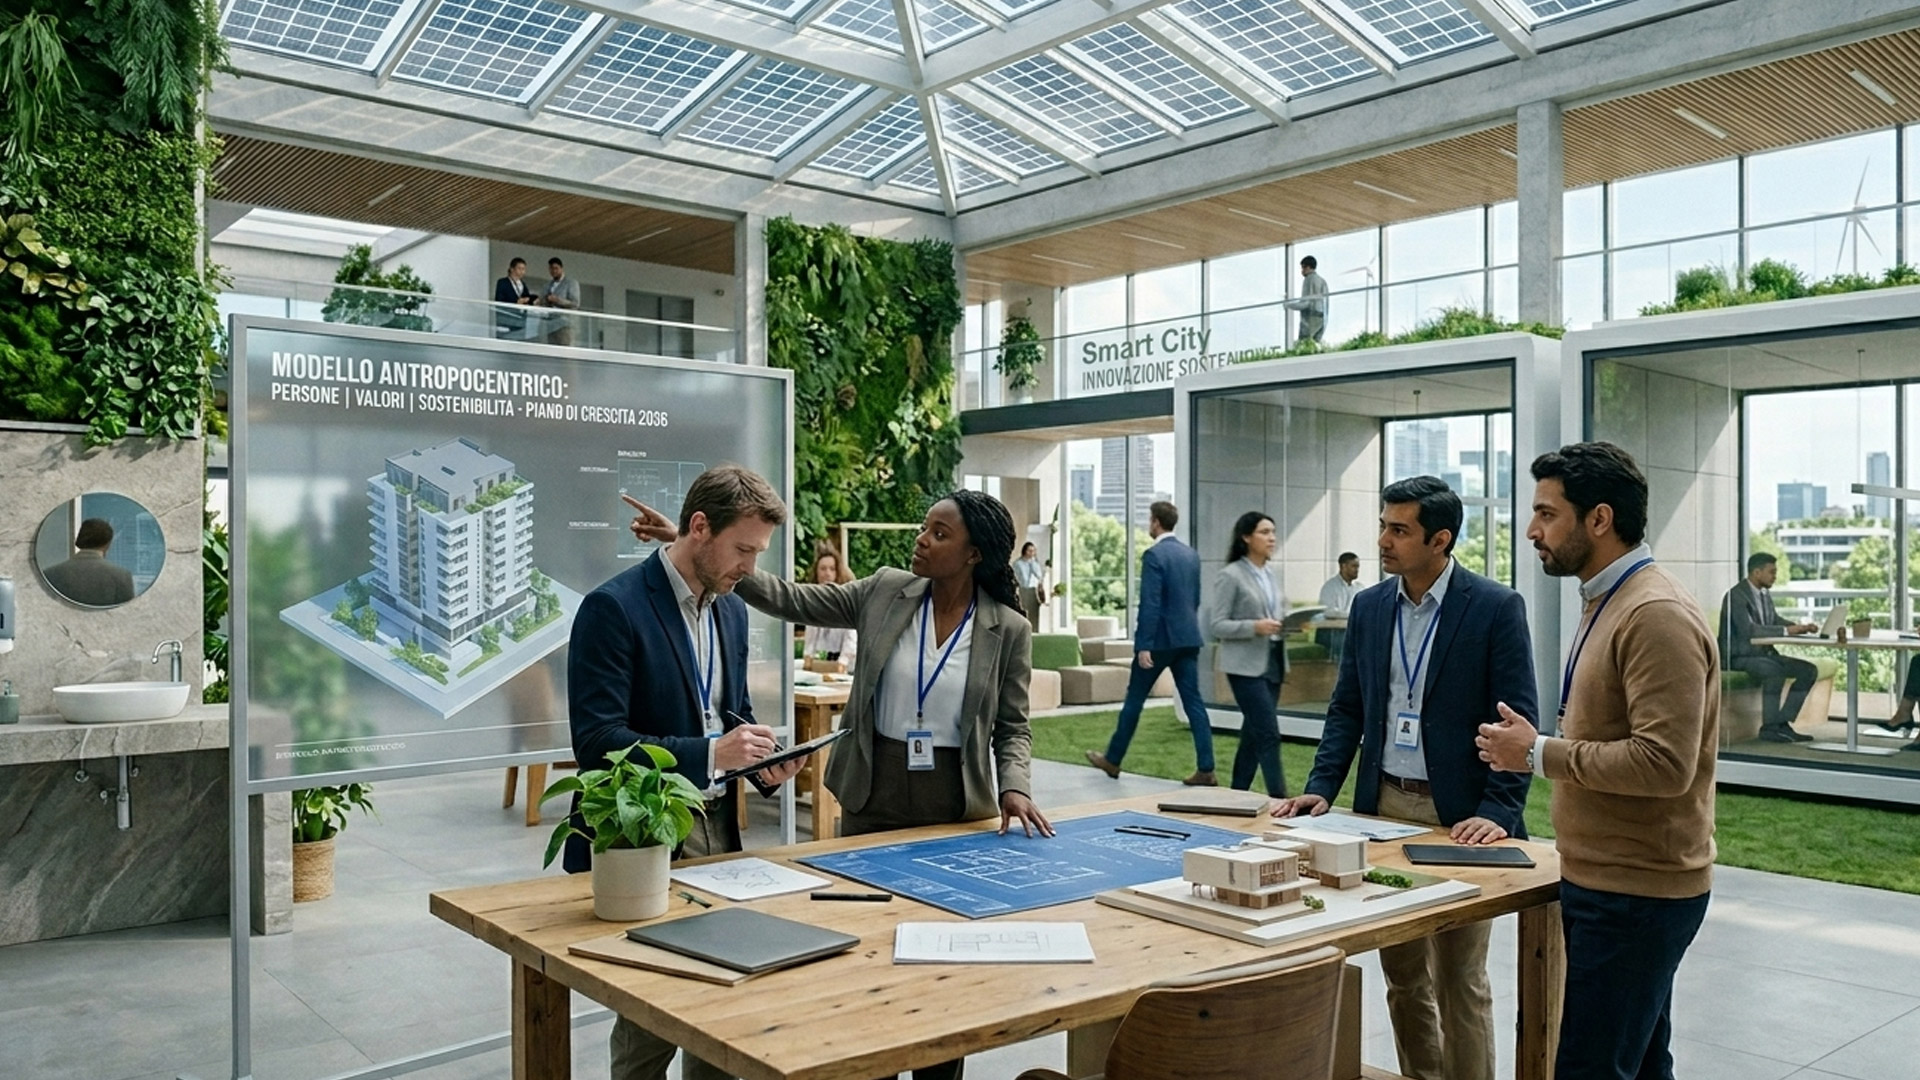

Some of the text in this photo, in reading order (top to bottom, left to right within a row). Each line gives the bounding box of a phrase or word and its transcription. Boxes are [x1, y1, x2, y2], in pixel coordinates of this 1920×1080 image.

[1082, 326, 1212, 365] Smart City
[272, 351, 569, 400] MODELLO ANTROPOCENTRICO:
[1082, 360, 1175, 391] INNOVAZIONE
[271, 382, 340, 405] PERSONE
[355, 388, 405, 409] VALORI
[565, 404, 578, 421] DI
[580, 405, 636, 425] CRESCITA
